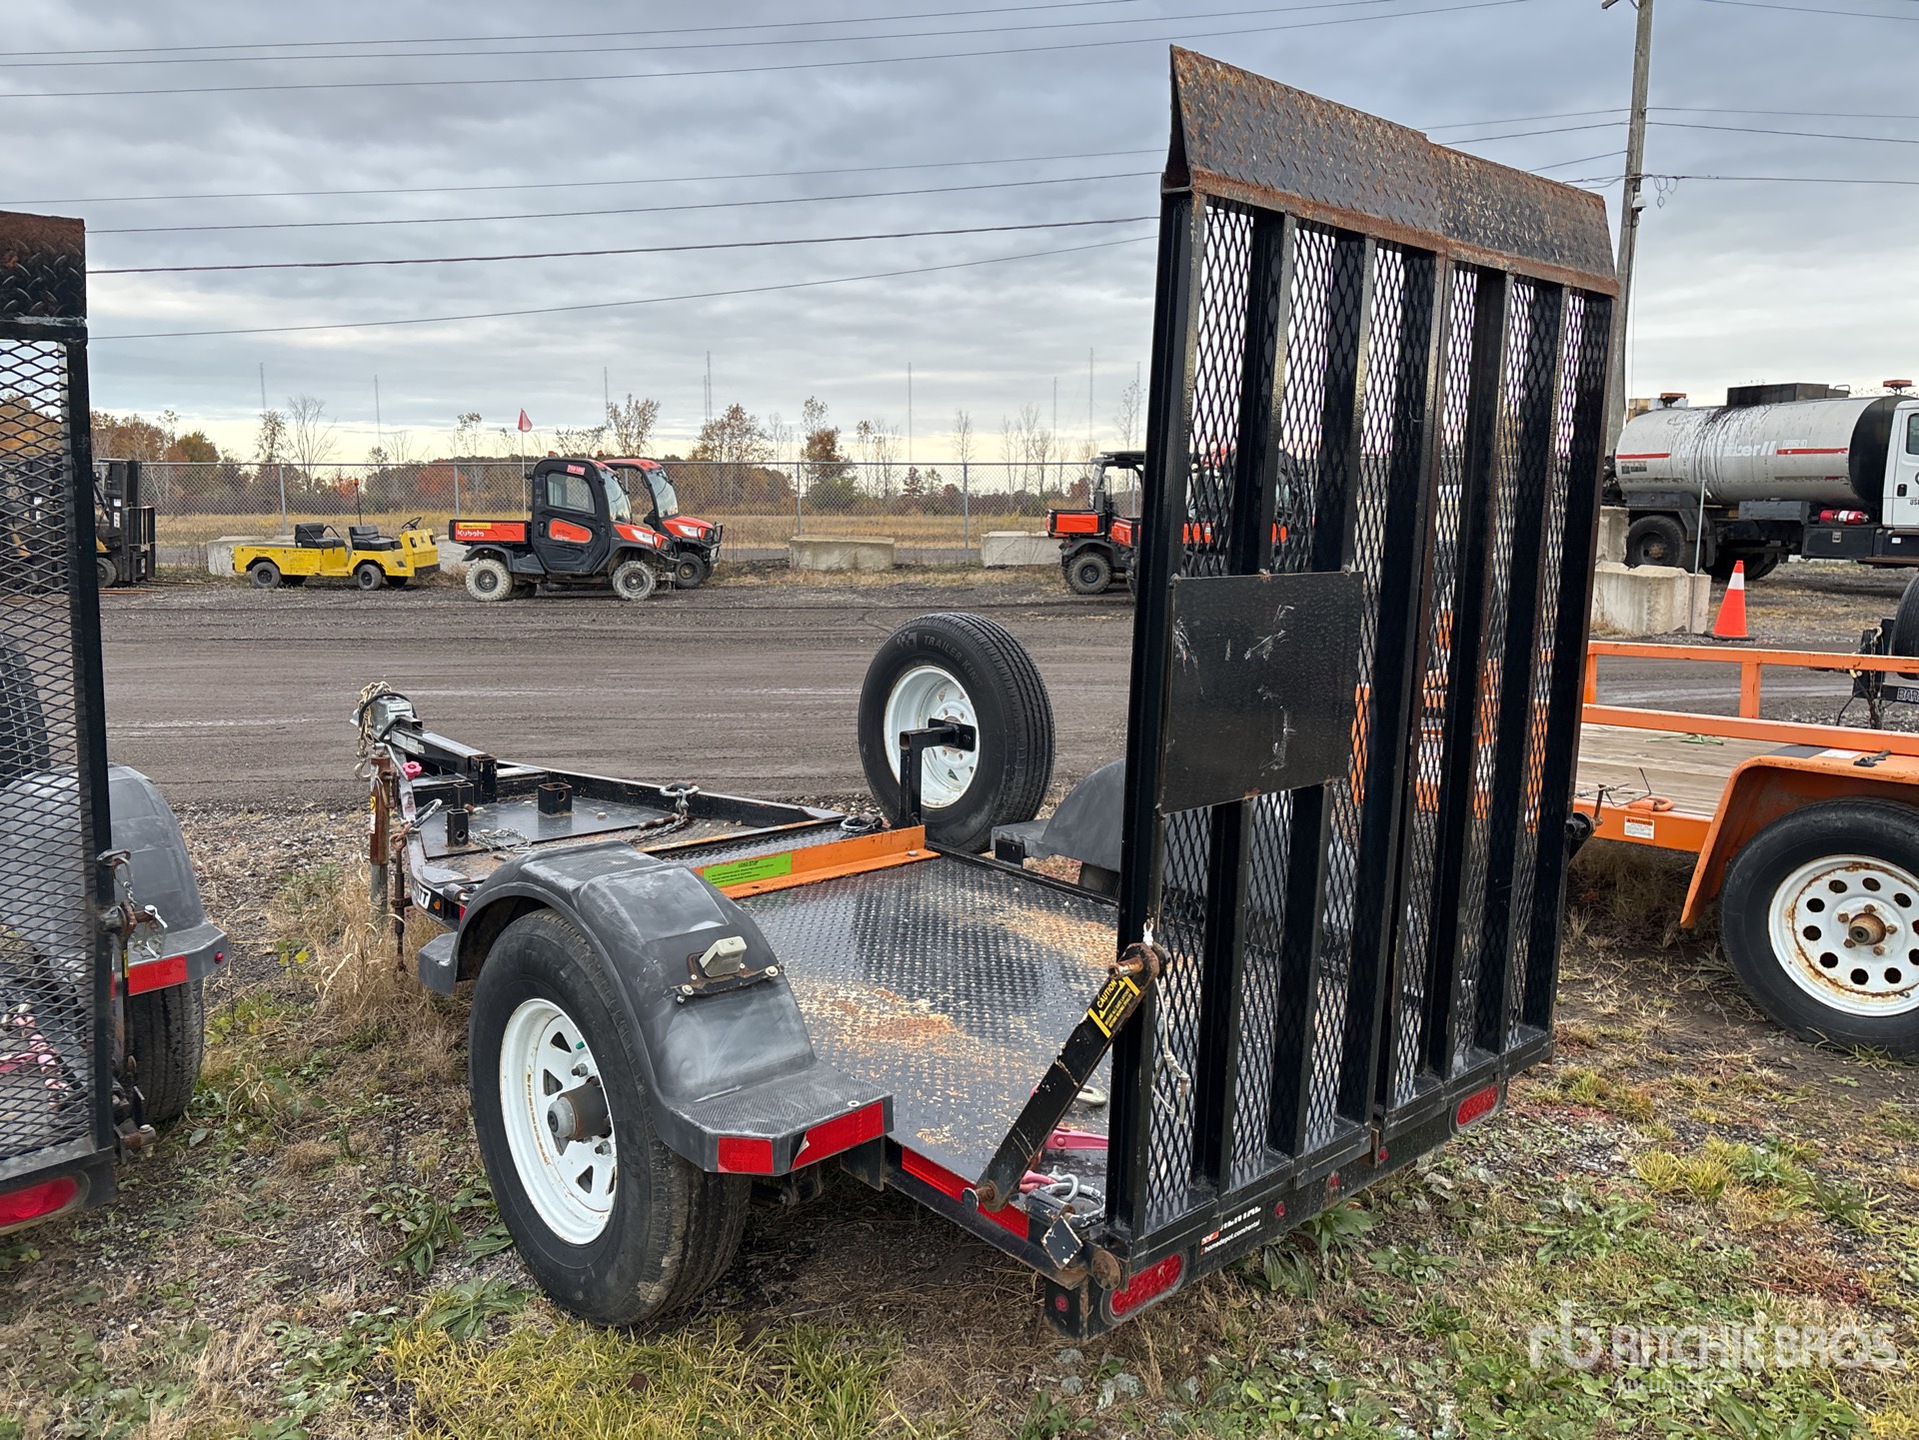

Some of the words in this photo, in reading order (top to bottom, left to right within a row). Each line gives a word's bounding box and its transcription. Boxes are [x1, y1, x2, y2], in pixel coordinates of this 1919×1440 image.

[457, 529, 485, 537] Kubota
[923, 635, 962, 659] TRAILER
[961, 659, 983, 689] KING
[1096, 979, 1117, 1008] CAUTION
[1204, 1219, 1261, 1253] homedepot.com/rental
